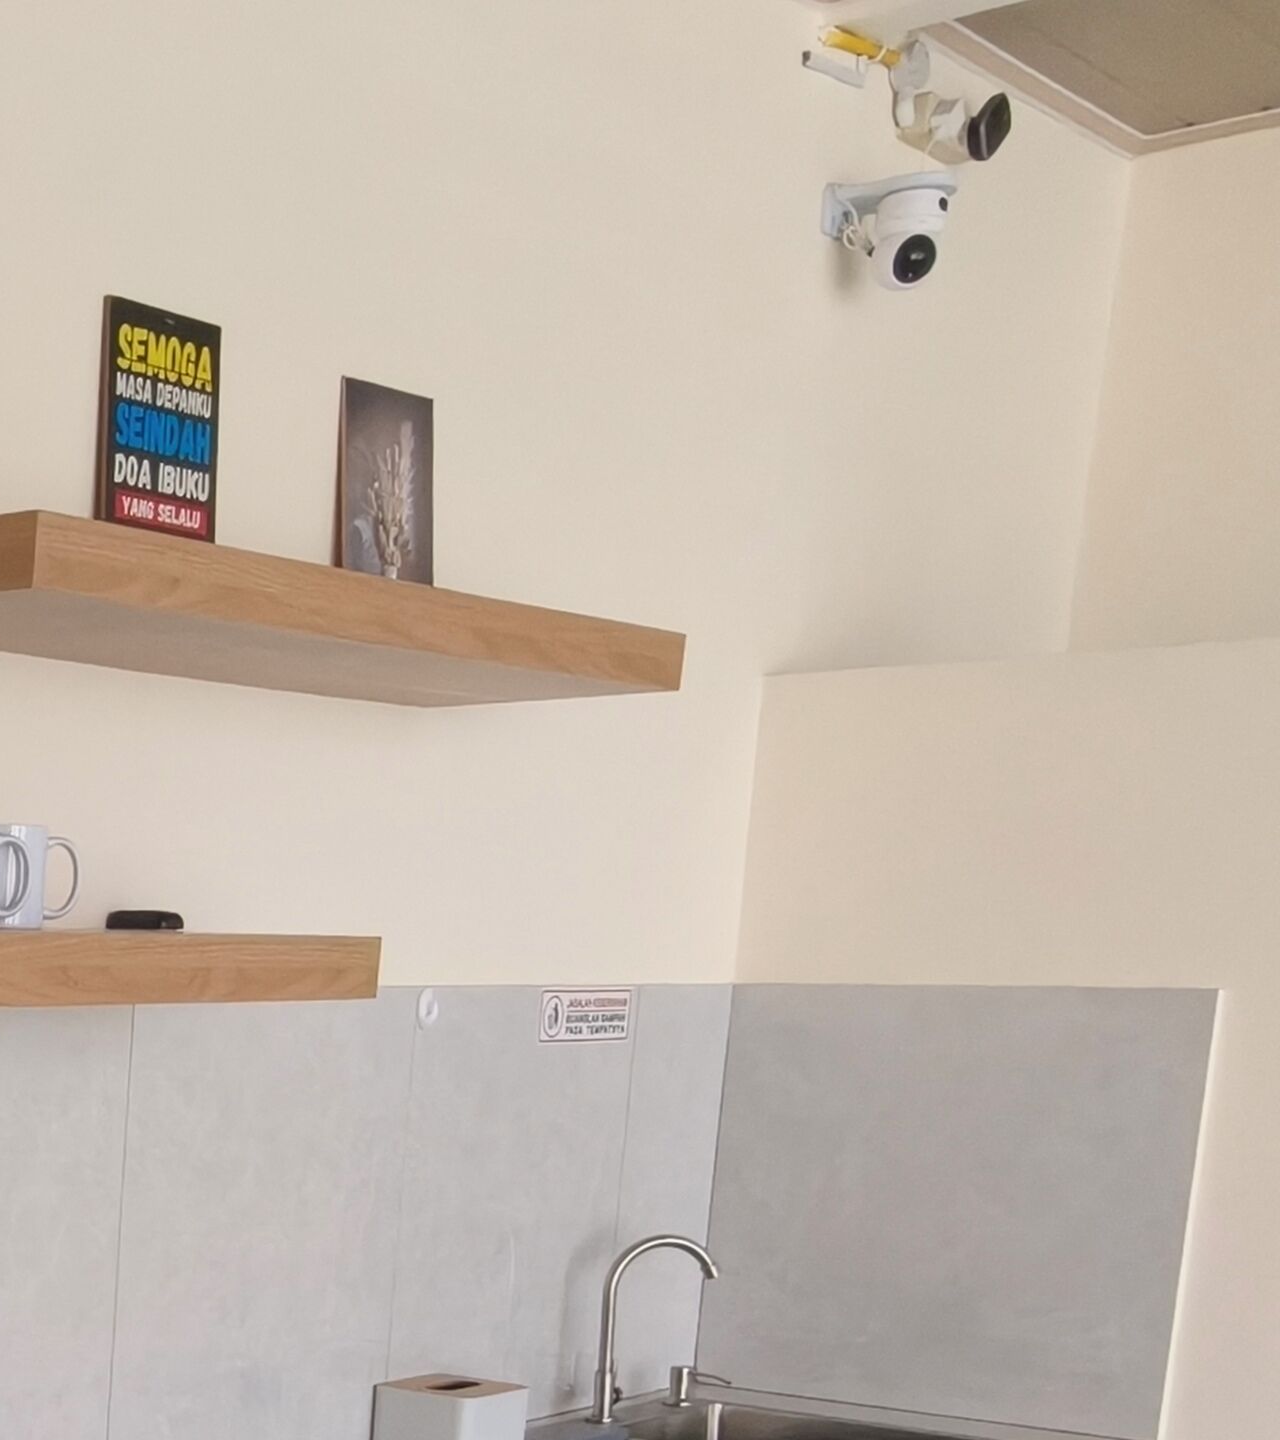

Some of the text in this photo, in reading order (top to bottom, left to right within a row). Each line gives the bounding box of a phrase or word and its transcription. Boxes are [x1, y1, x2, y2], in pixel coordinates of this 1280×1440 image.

[117, 323, 213, 392] SEMOGA
[116, 371, 212, 419] MASA DEPANKU
[115, 402, 212, 465] SEINDAH
[113, 453, 210, 502] DOA IBUKU
[122, 495, 201, 529] YANG SELALU
